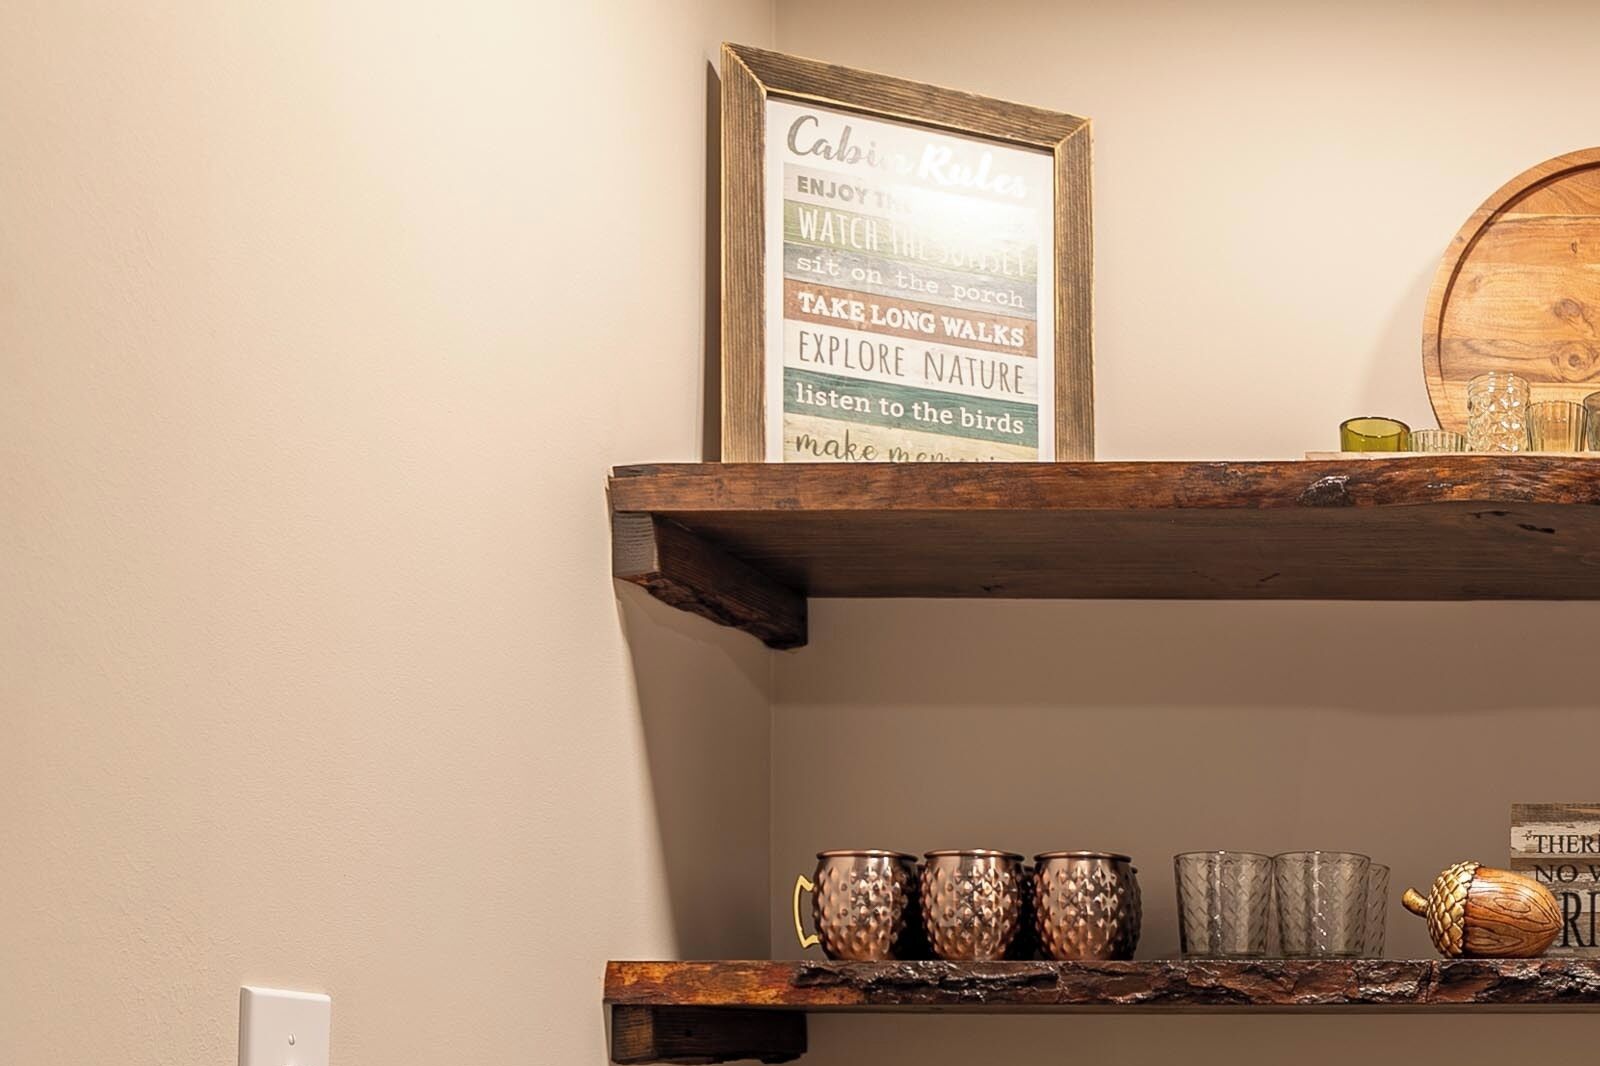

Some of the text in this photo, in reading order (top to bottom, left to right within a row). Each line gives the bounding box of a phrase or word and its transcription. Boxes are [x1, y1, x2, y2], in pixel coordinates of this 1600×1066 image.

[797, 176, 867, 203] ENJOY
[917, 144, 1025, 197] Rules
[798, 207, 878, 251] WATCH
[797, 256, 1024, 308] sit on the porch
[798, 292, 1024, 347] TAKE LONG WALKS
[799, 331, 1024, 394] EXPLORE NATURE
[796, 382, 1024, 434] listen to the birds
[796, 429, 878, 462] make
[1534, 864, 1578, 883] NO
